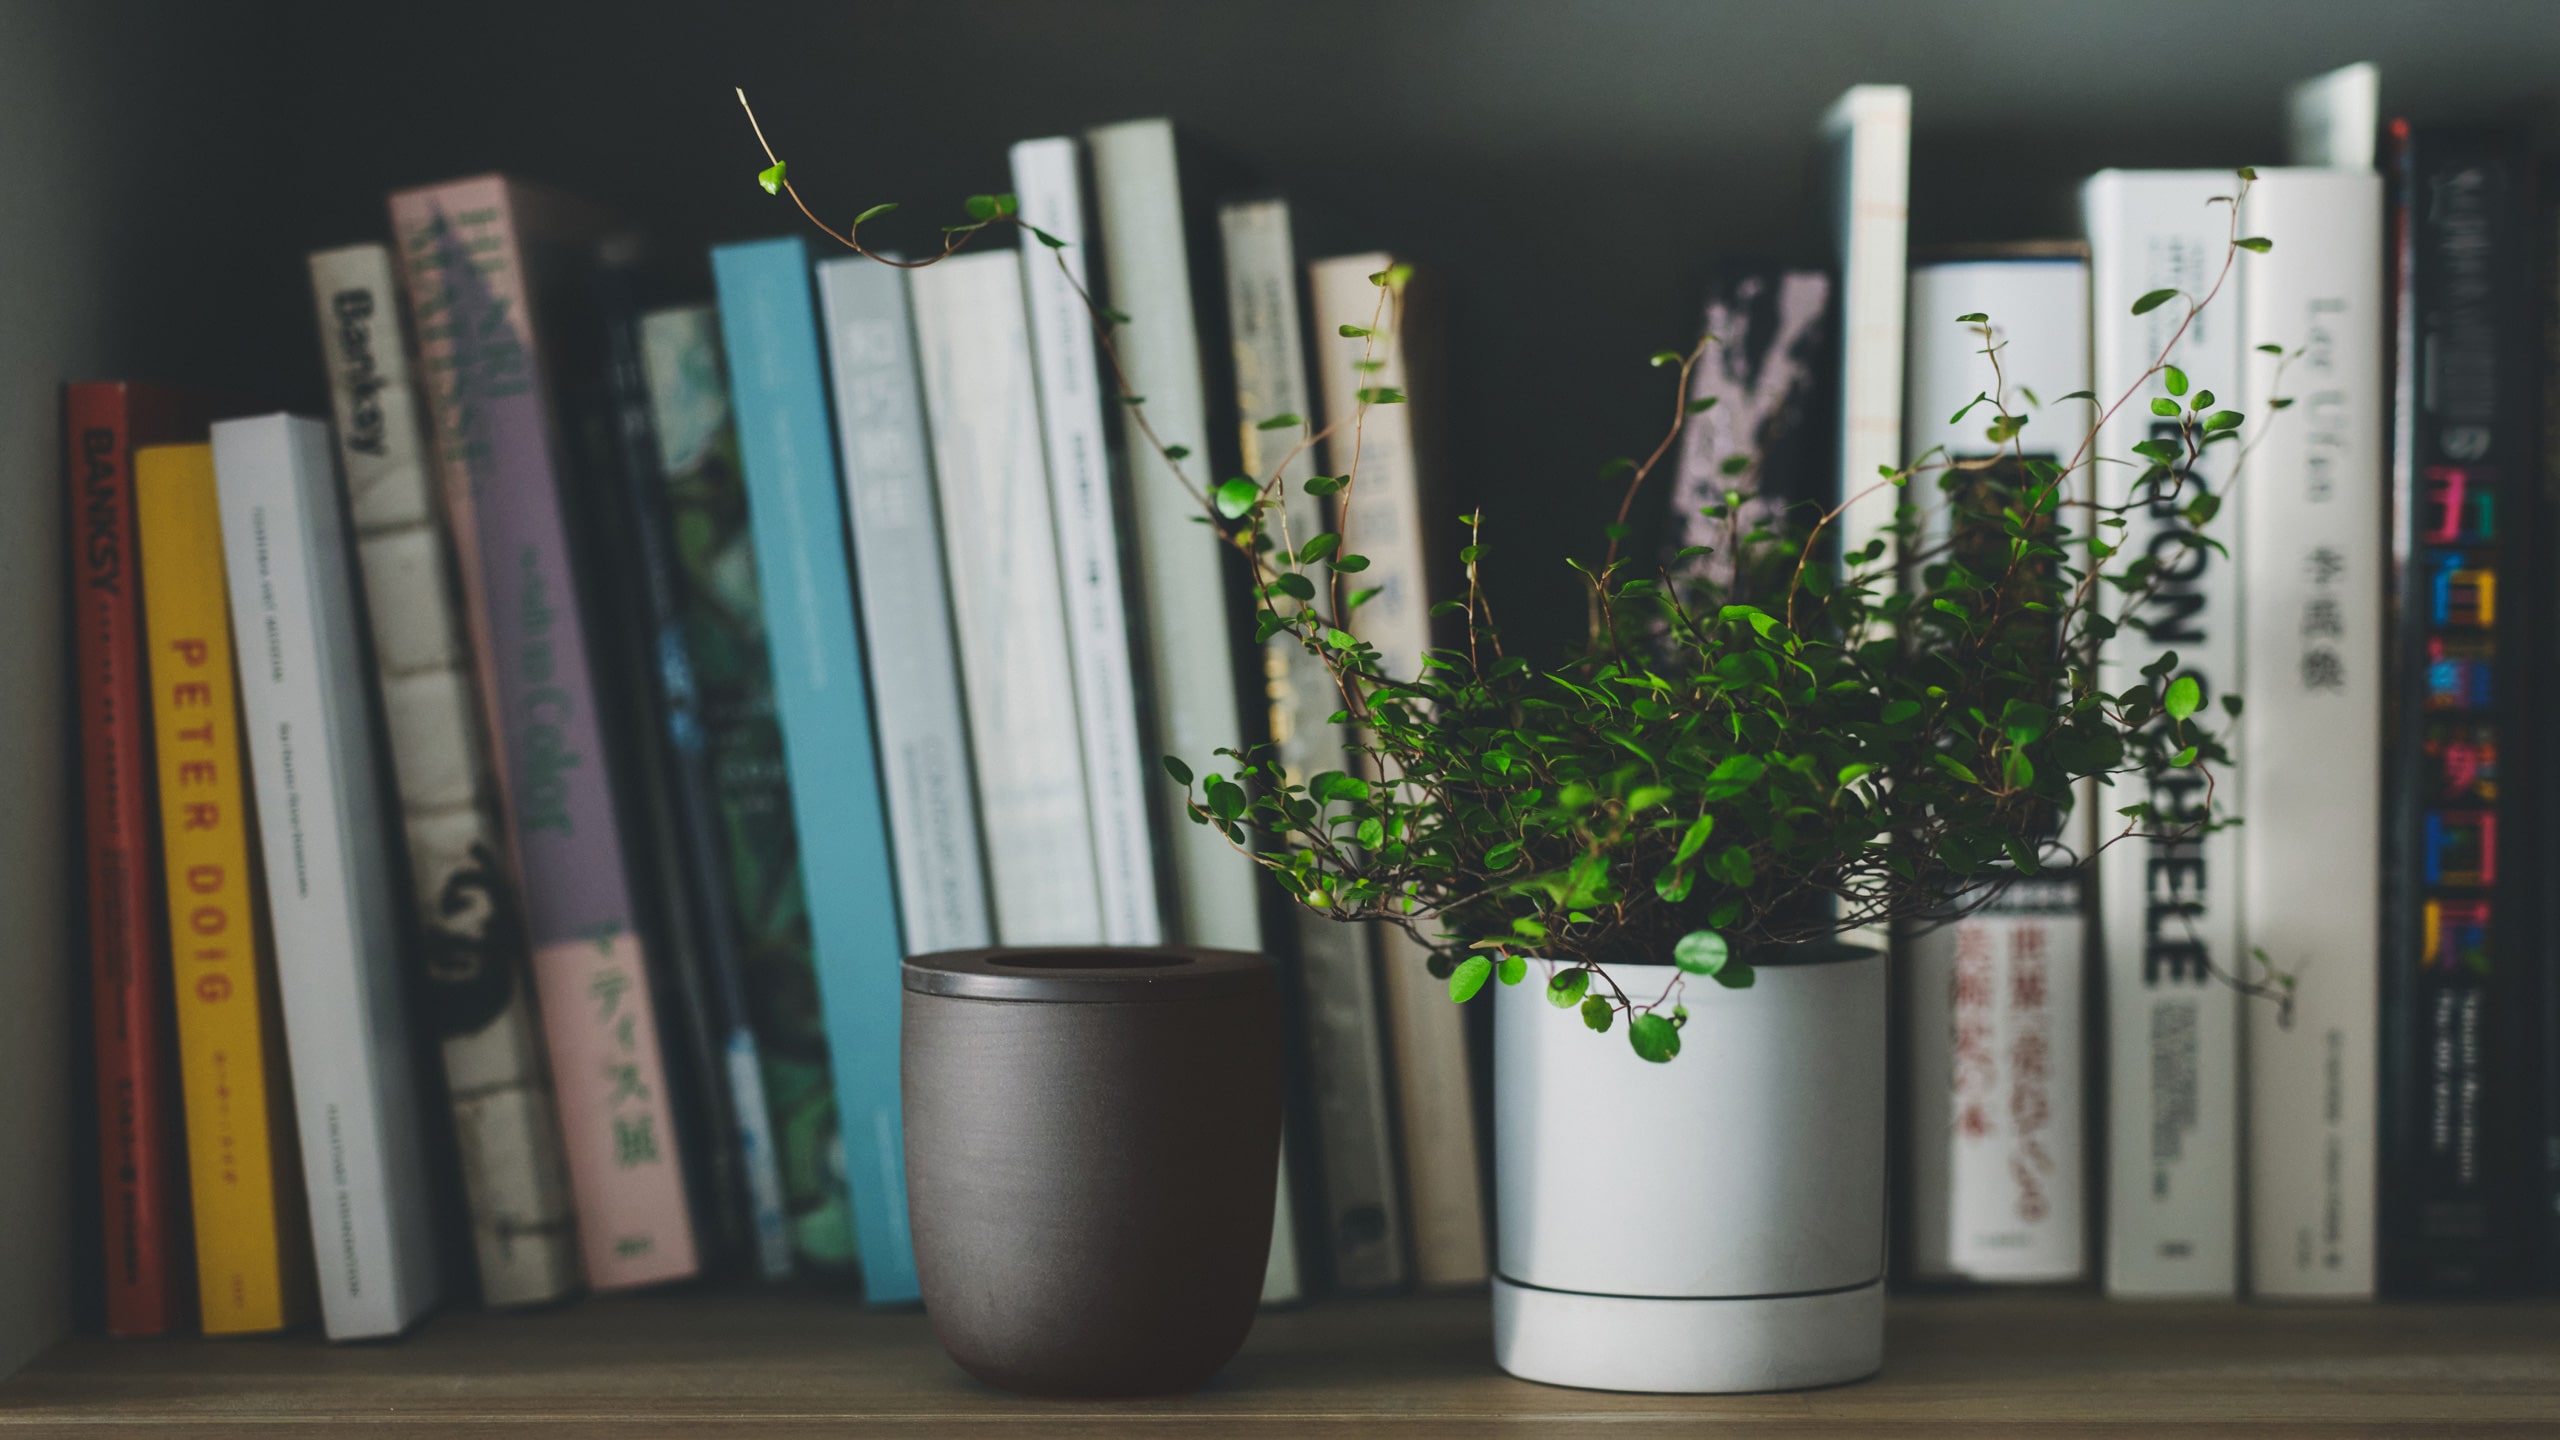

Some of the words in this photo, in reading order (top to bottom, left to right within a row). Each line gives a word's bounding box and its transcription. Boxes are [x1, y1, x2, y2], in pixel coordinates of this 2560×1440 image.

[333, 287, 387, 457] Banksy
[83, 427, 121, 597] BANKSY
[171, 638, 220, 832] PETER
[187, 864, 233, 1005] DOIG
